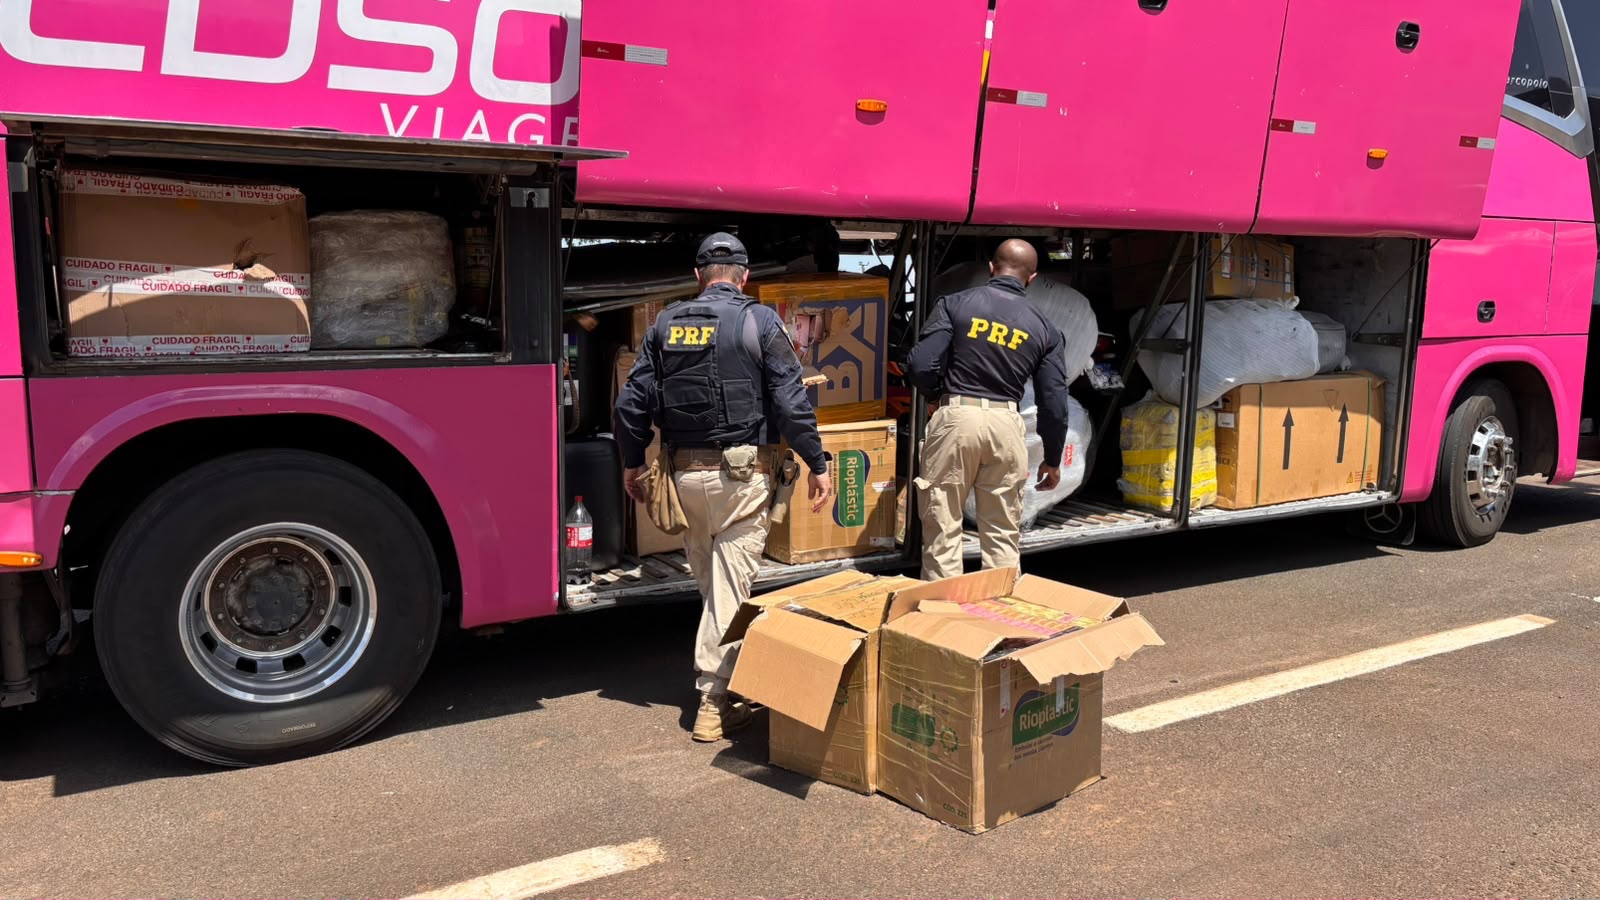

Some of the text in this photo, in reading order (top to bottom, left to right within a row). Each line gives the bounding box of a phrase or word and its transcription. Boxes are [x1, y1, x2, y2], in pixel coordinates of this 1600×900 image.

[65, 258, 159, 274] CUIDADO FRAGIL
[142, 282, 192, 293] CUIDADO
[193, 284, 232, 293] FRAGIL
[152, 335, 240, 345] CUIDADO FRAGIL
[667, 325, 717, 346] PRF
[966, 316, 1029, 351] PRF
[844, 456, 859, 521] Rioplastic
